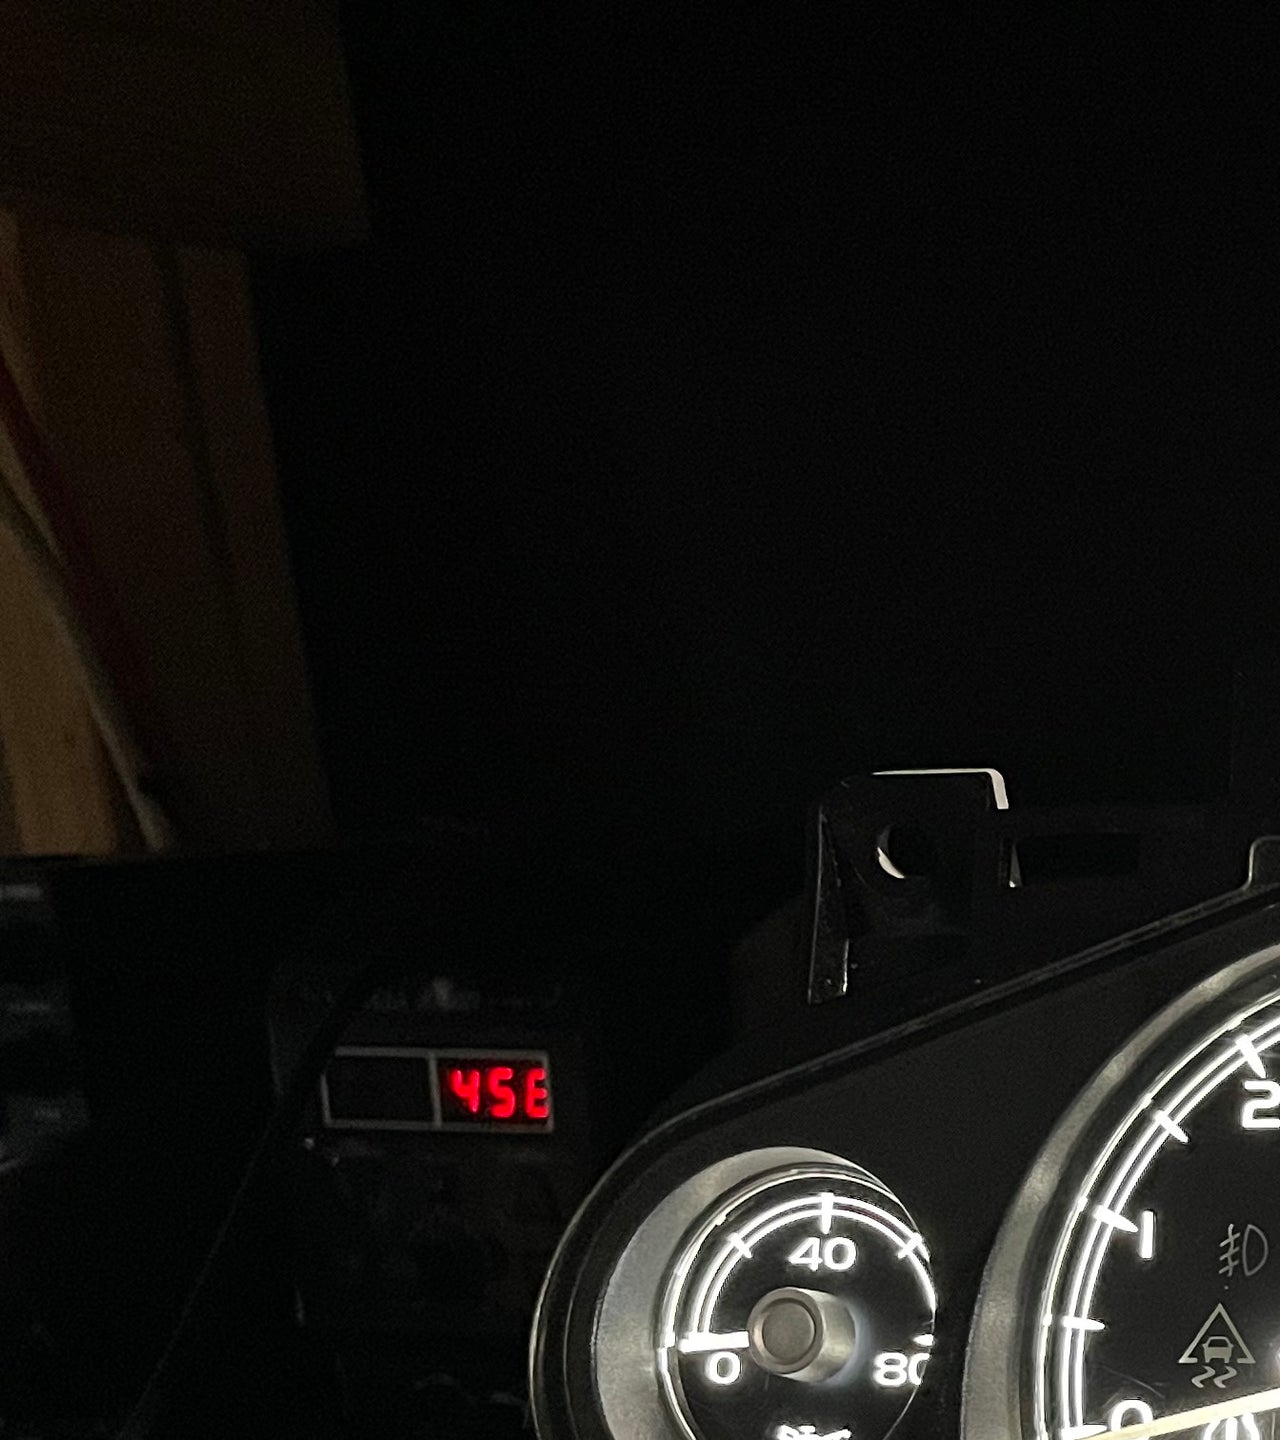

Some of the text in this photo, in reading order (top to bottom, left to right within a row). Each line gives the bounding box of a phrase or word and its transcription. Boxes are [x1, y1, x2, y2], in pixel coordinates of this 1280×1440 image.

[1142, 1212, 1153, 1258] 1
[789, 1237, 856, 1270] 40
[707, 1352, 740, 1384] 0
